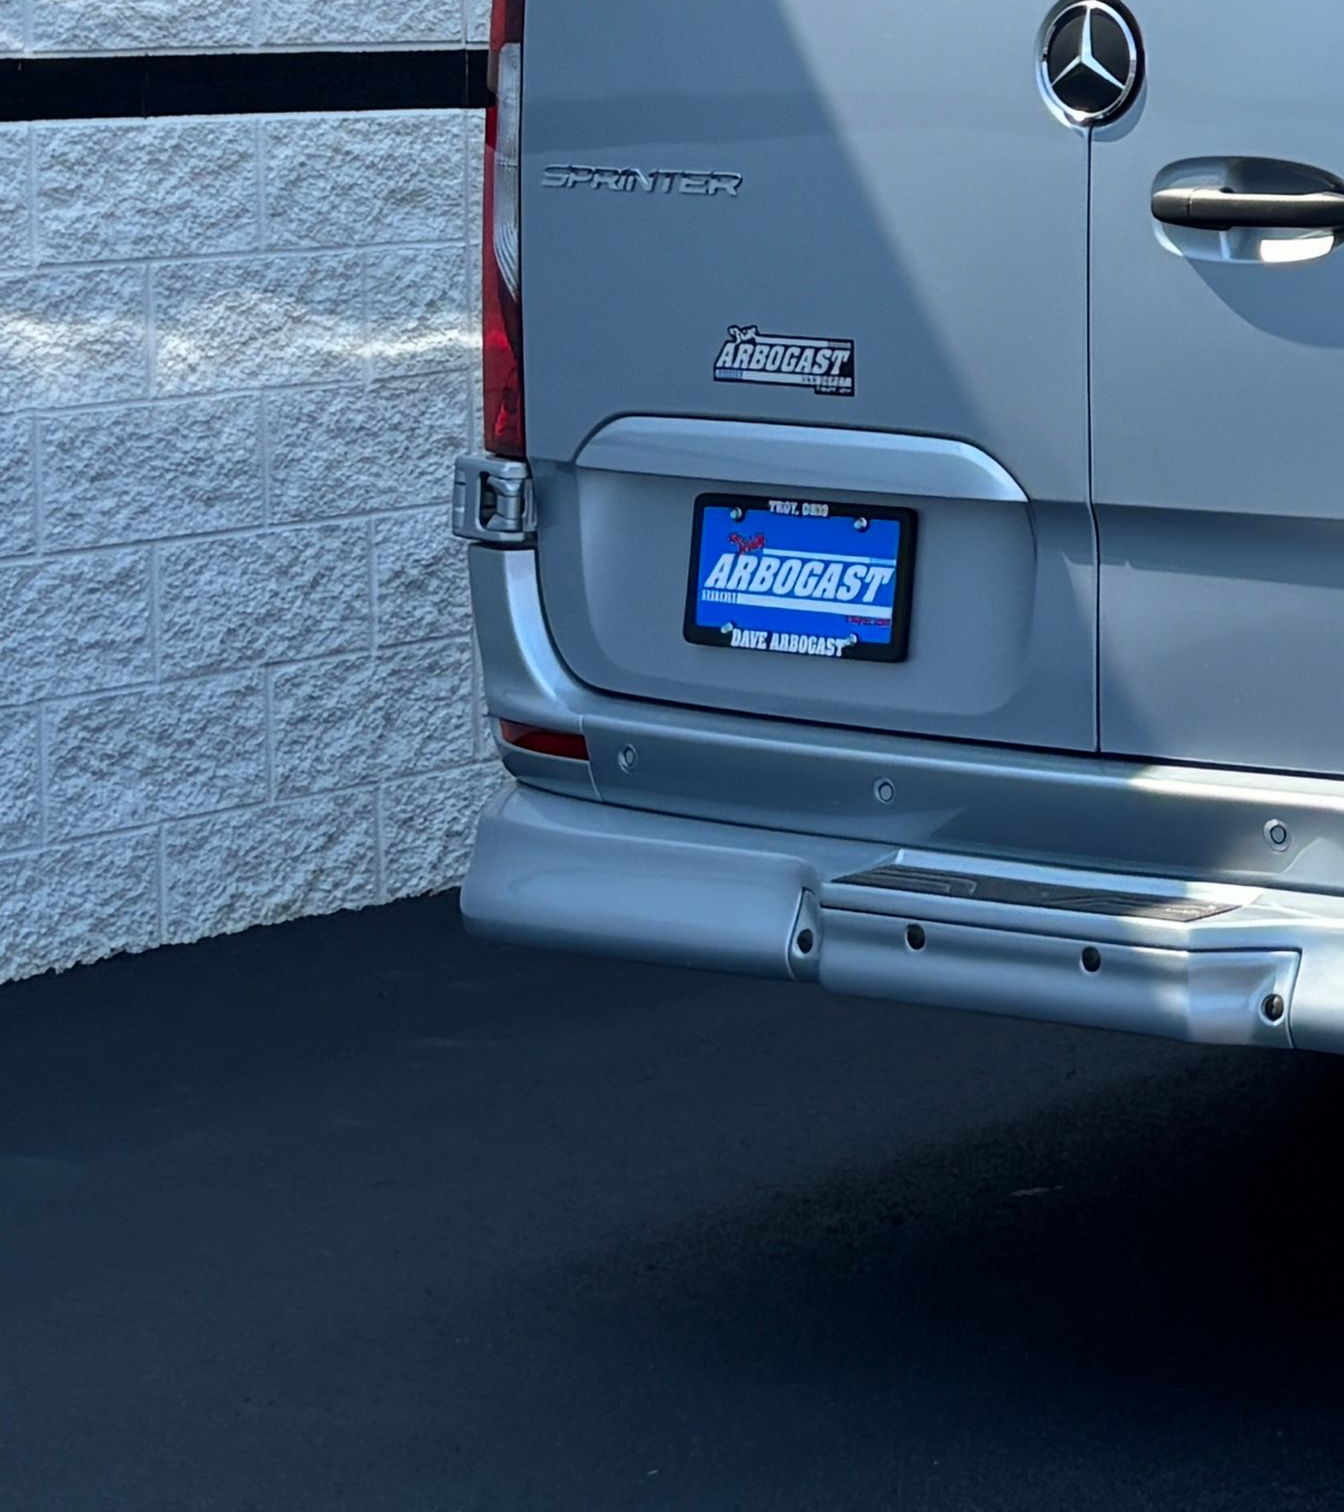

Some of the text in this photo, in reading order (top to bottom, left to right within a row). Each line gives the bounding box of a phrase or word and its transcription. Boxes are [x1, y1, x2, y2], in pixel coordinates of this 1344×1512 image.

[540, 163, 743, 197] SPRINTER
[716, 342, 850, 375] ARBOGAST
[704, 553, 894, 603] ARBOGAST
[730, 627, 848, 657] DAVE ARBOGAST
